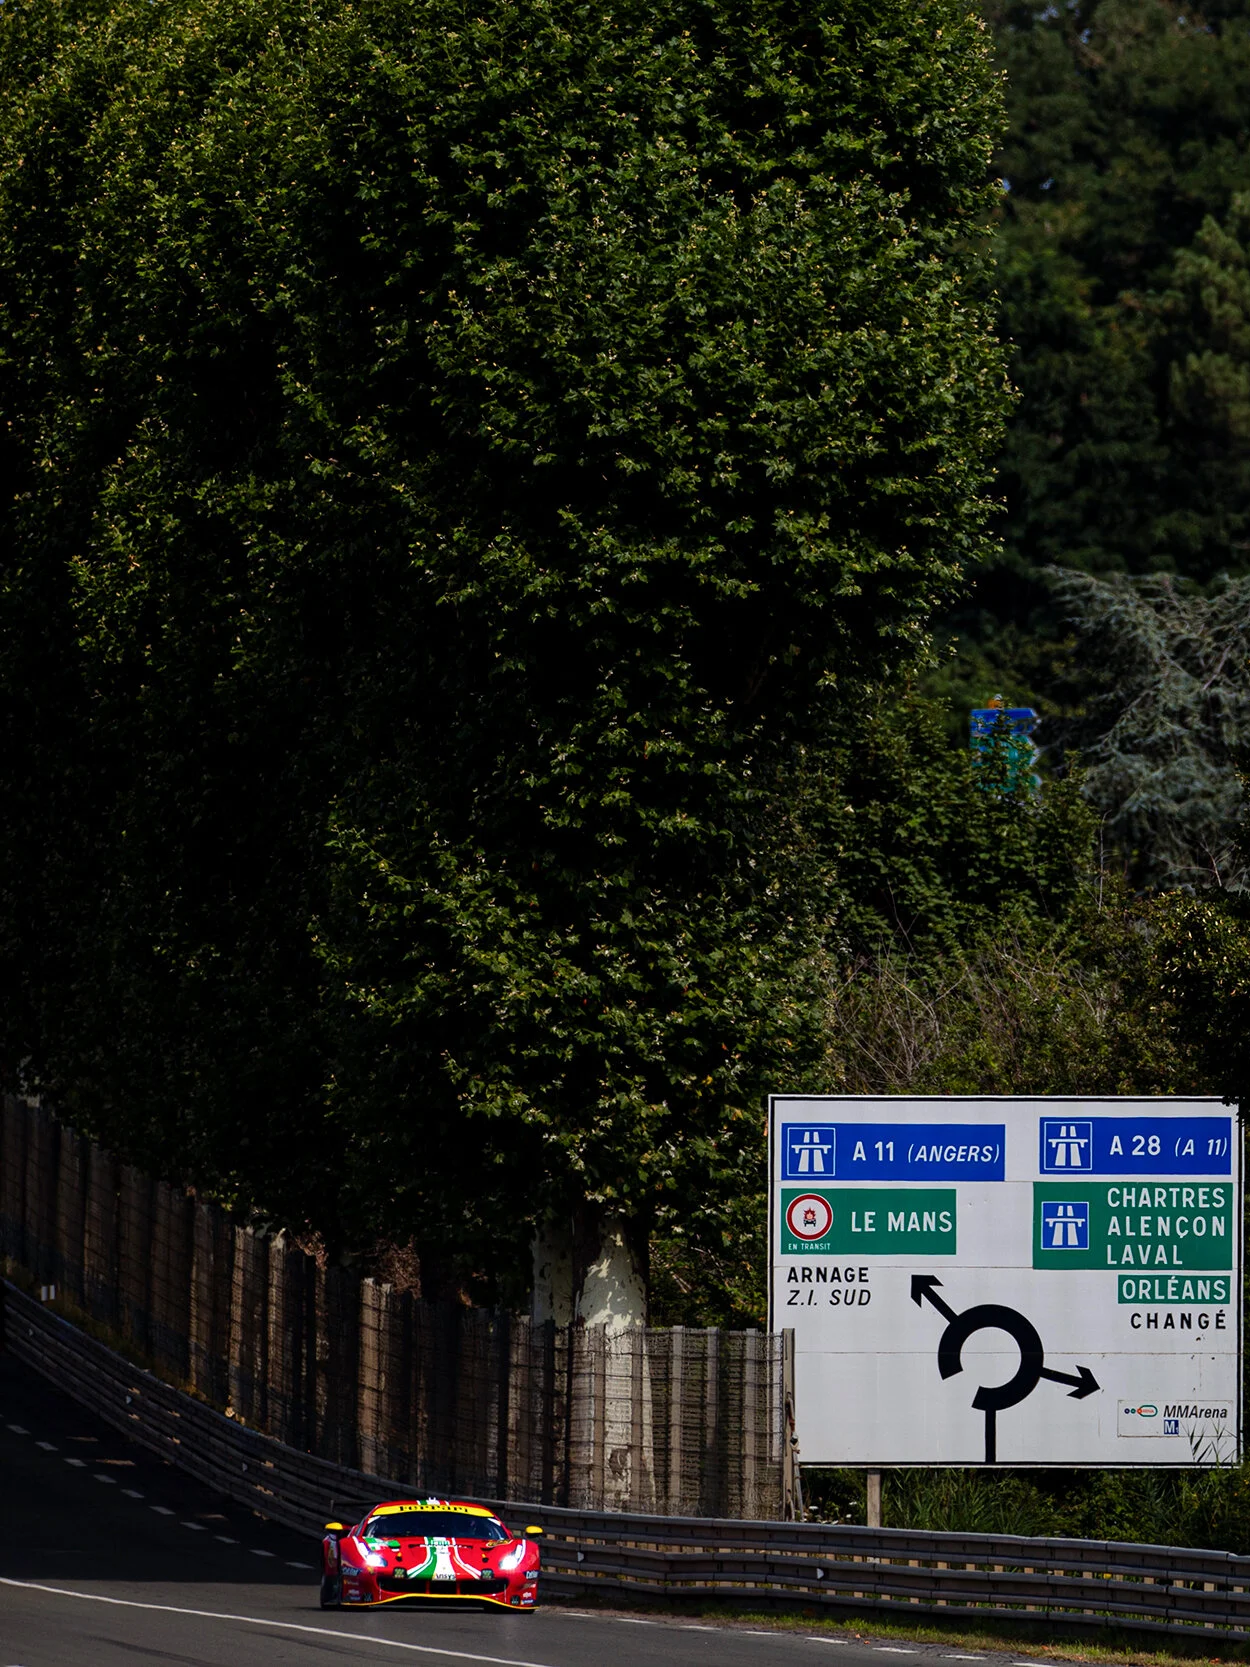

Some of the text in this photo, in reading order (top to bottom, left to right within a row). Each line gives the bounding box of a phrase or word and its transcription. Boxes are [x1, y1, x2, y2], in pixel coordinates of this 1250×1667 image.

[852, 1141, 1000, 1164] A 11 (ANGERS)
[1109, 1134, 1228, 1157] A 28 (A 11)
[1107, 1187, 1226, 1208] CHARTRES
[851, 1211, 953, 1233] LE MANS
[1107, 1216, 1226, 1239] ALENÇON
[788, 1243, 798, 1251] EN
[1107, 1244, 1183, 1265] LAVAL
[786, 1266, 869, 1283] ARNAGE
[786, 1289, 871, 1306] Z.I. SUD
[1122, 1275, 1226, 1300] ORLÉANS
[1130, 1309, 1226, 1329] CHANGÉ
[1163, 1405, 1228, 1419] MMArena
